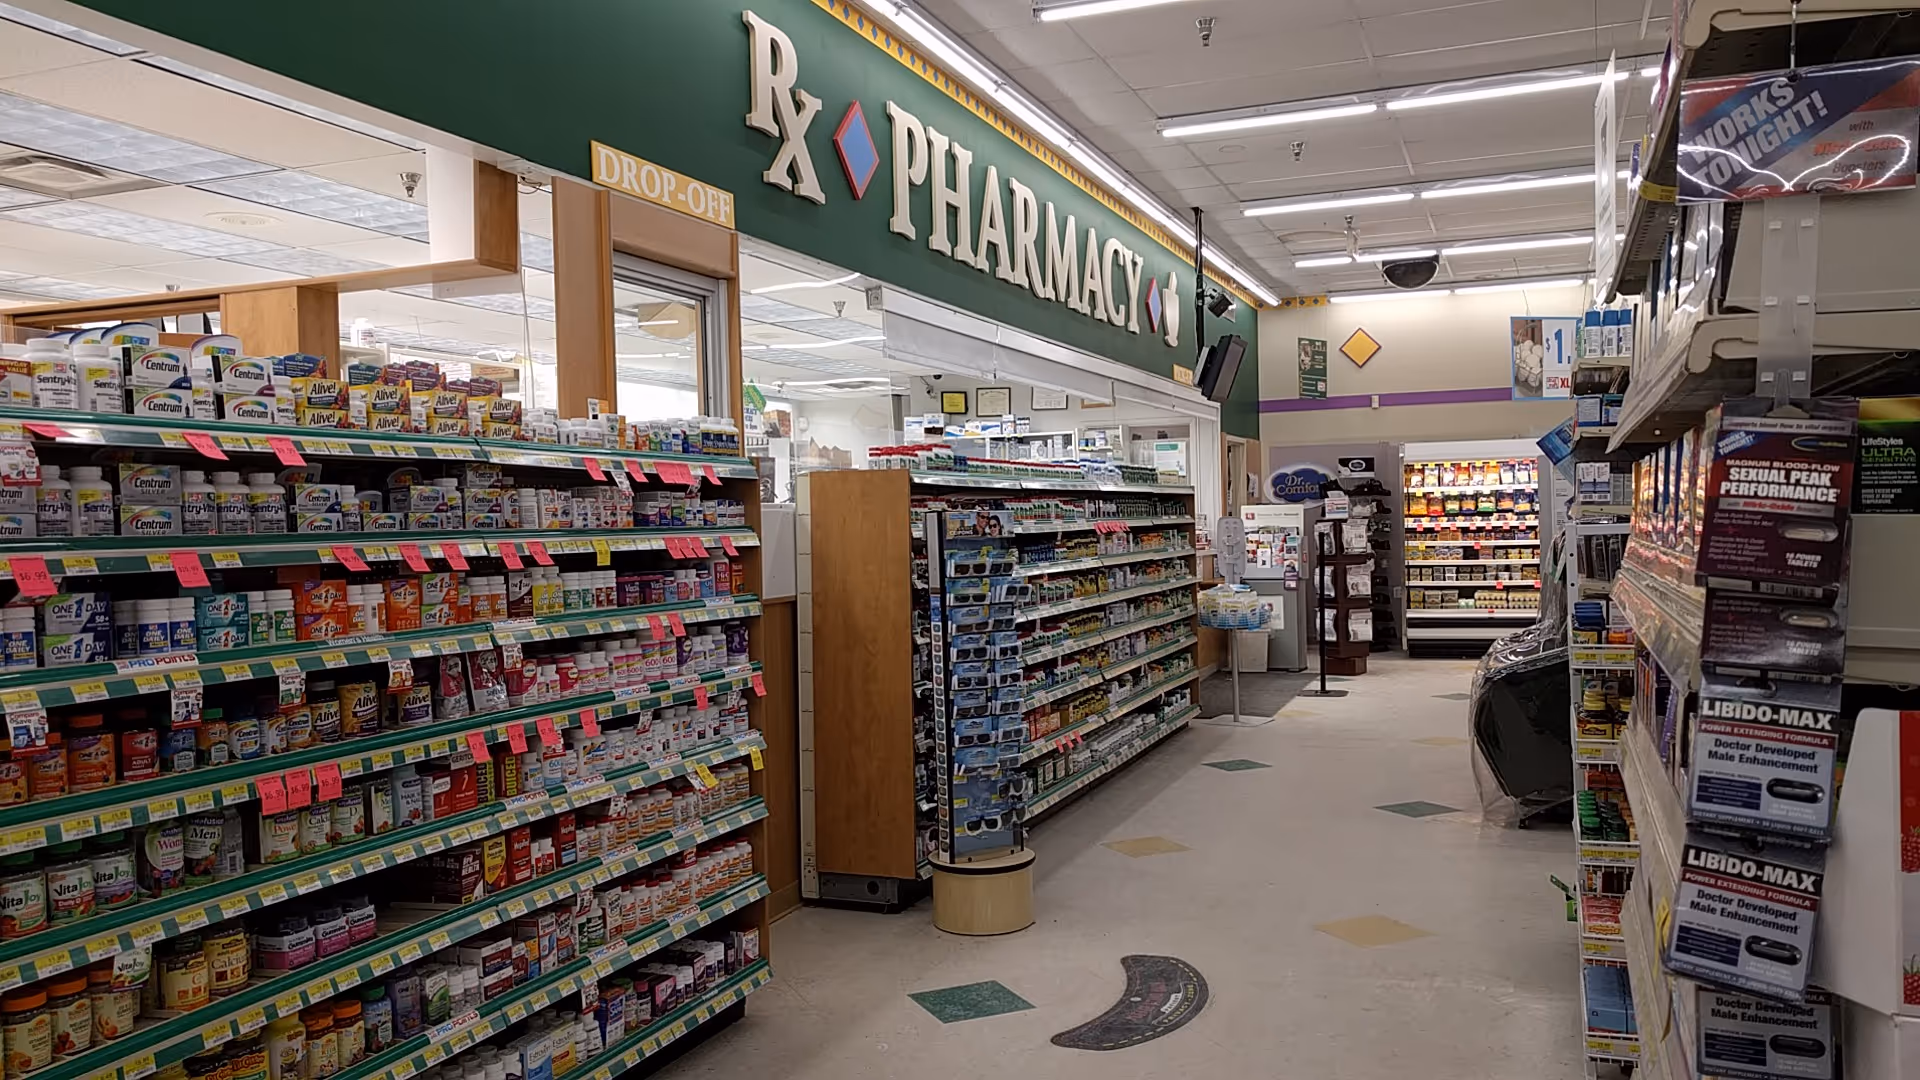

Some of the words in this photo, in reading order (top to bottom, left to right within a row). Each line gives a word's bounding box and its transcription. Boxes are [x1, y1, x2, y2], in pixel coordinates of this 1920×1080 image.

[1686, 79, 1795, 166] WORKS
[1849, 120, 1874, 131] with
[1693, 91, 1829, 196] TONIGHT!
[597, 146, 730, 223] DROP-OFF
[886, 99, 1144, 334] PHARMACY
[145, 359, 181, 374] Centrum
[233, 368, 265, 381] Centrum
[309, 382, 337, 396] Alive!
[1559, 377, 1571, 389] XL
[374, 387, 398, 401] Alive!
[435, 394, 457, 407] Alive!
[147, 400, 183, 414] Centrum
[237, 407, 269, 420] Centrum
[491, 401, 512, 413] Alive!
[309, 410, 337, 426] Alive!
[375, 415, 400, 430] Alive!
[437, 420, 459, 434] Alive!
[493, 425, 512, 438] Alive!
[1718, 431, 1747, 449] WORKS
[1861, 436, 1904, 447] LifeStyles
[1861, 447, 1917, 457] ULTRA
[1726, 459, 1770, 468] MAGNUM
[1772, 461, 1841, 472] BLOOD-FLOW
[134, 477, 172, 489] Centrum
[1285, 475, 1305, 486] Dr.
[1729, 467, 1788, 484] SEXUAL
[1789, 471, 1833, 487] PEAK
[308, 494, 331, 503] Centrum
[474, 495, 494, 503] Centrum
[134, 518, 172, 530] Centrum
[374, 521, 397, 529] Centrum
[417, 521, 439, 529] Centrum
[474, 520, 494, 528] Centrum
[1787, 560, 1818, 568] TABLETS
[1795, 553, 1822, 562] POWER
[18, 571, 48, 581] $6.99
[426, 582, 439, 591] ONE
[310, 593, 324, 601] ONE
[329, 592, 342, 600] DAY
[392, 591, 403, 599] ONE
[52, 603, 74, 615] ONE
[85, 602, 106, 613] DAY
[207, 604, 223, 613] ONE
[231, 603, 245, 612] DAY
[425, 613, 438, 621] ONE
[145, 629, 162, 637] ONE
[310, 626, 324, 634] ONE
[329, 625, 343, 633] DAY
[173, 633, 195, 641] DAILY
[207, 636, 223, 646] ONE
[231, 634, 245, 644] DAY
[51, 644, 73, 655] ONE
[84, 641, 106, 652] DAY
[1788, 647, 1820, 656] TABLETS
[1795, 641, 1822, 650] POWER
[9, 712, 40, 720] Compare
[1701, 700, 1833, 731] LIBIDO-MAX
[1701, 723, 1732, 733] POWER
[1733, 727, 1783, 740] EXTENDING
[1785, 733, 1829, 746] FORMULA
[1714, 738, 1752, 751] Doctor
[1755, 743, 1816, 761] Developed
[451, 753, 474, 764] GERITO
[1708, 749, 1736, 763] Male
[1738, 753, 1819, 774] Enhancement
[1717, 814, 1755, 825] SUPPLEMENT
[190, 826, 221, 840] Men's
[1686, 848, 1816, 893] LIBIDO-MAX
[1684, 872, 1715, 885] POWER
[1716, 879, 1766, 897] EXTENDING
[1768, 891, 1811, 908] FORMULA
[1697, 888, 1735, 907] Doctor
[1737, 898, 1798, 922] Developed
[1689, 900, 1717, 915] Male
[1719, 906, 1800, 936] Enhancement
[1695, 966, 1732, 981] SUPPLEMENT
[1716, 997, 1753, 1010] Doctor
[1755, 1000, 1815, 1017] Developed
[1711, 1008, 1738, 1021] Male
[1741, 1011, 1819, 1029] Enhancement
